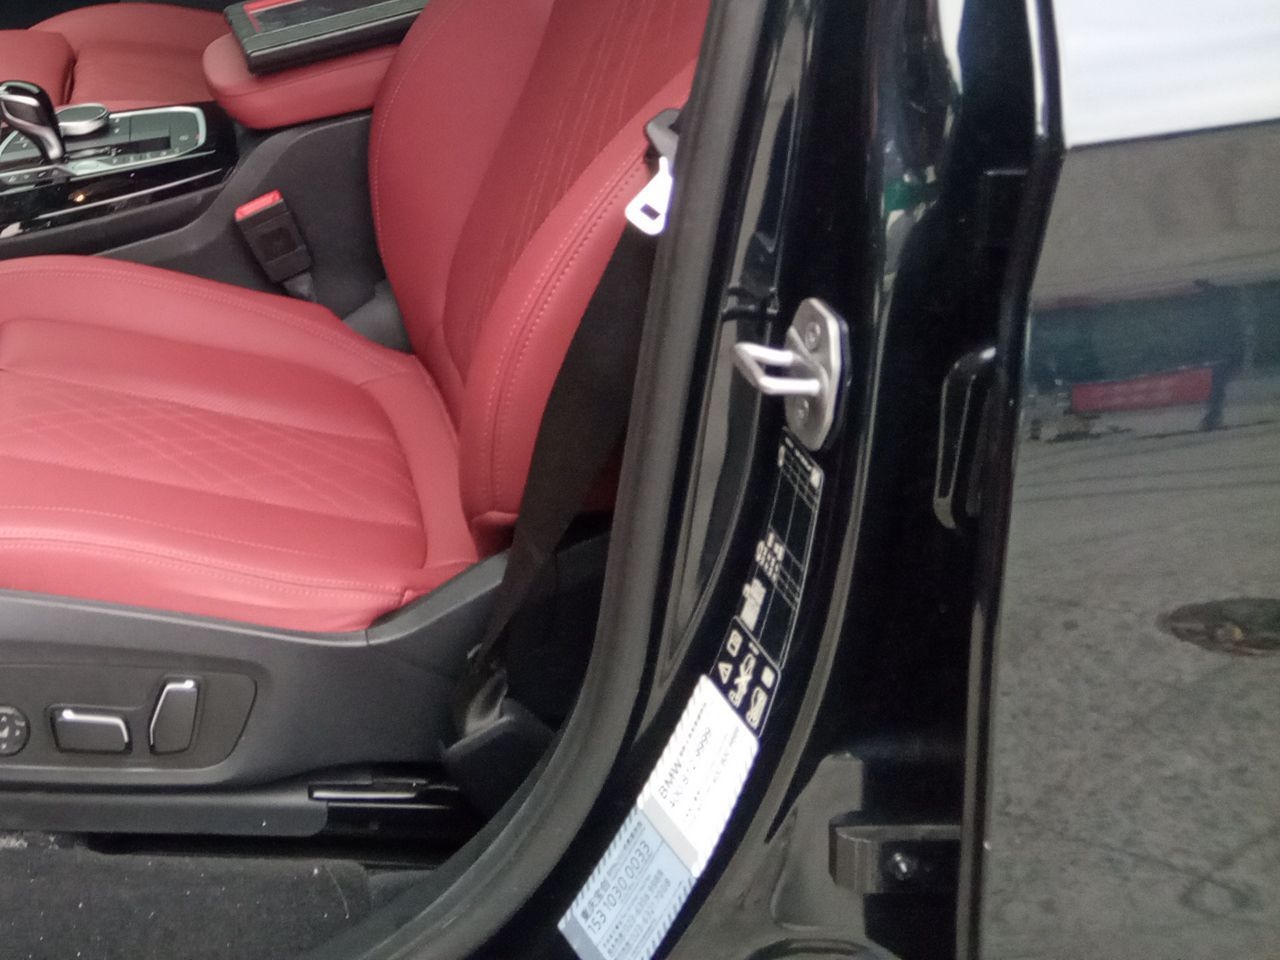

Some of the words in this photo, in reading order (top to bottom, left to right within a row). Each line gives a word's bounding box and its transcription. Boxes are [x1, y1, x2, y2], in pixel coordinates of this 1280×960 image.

[658, 761, 682, 799] BMW
[587, 913, 607, 935] 153
[603, 877, 628, 912] 1030
[625, 840, 651, 879] 0033
